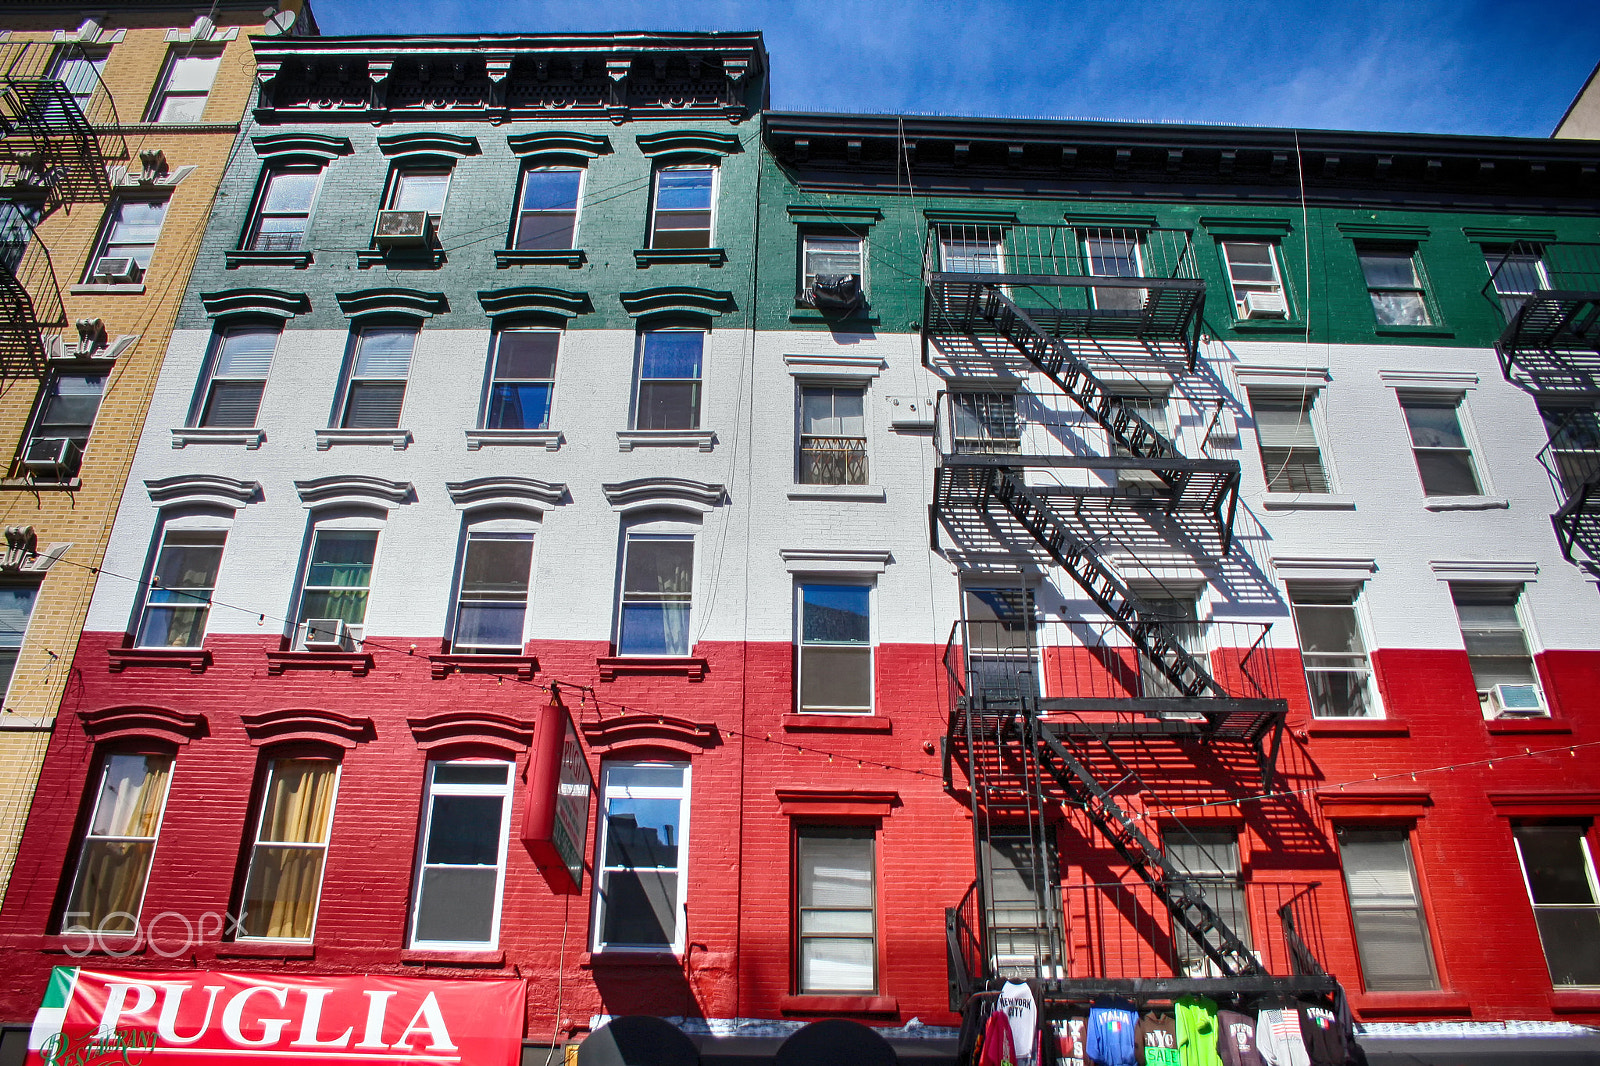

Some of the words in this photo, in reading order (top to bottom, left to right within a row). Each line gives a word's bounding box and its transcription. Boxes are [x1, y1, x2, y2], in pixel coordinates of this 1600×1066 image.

[1000, 996, 1013, 1008] NEW
[1014, 998, 1031, 1010] YORK
[92, 982, 459, 1052] PUGLIA
[1008, 1007, 1023, 1018] CITY
[1099, 1010, 1129, 1025] ITALIA
[1306, 1007, 1336, 1023] ITALIA
[1145, 1029, 1173, 1047] NYC
[1147, 1049, 1177, 1063] SALE
